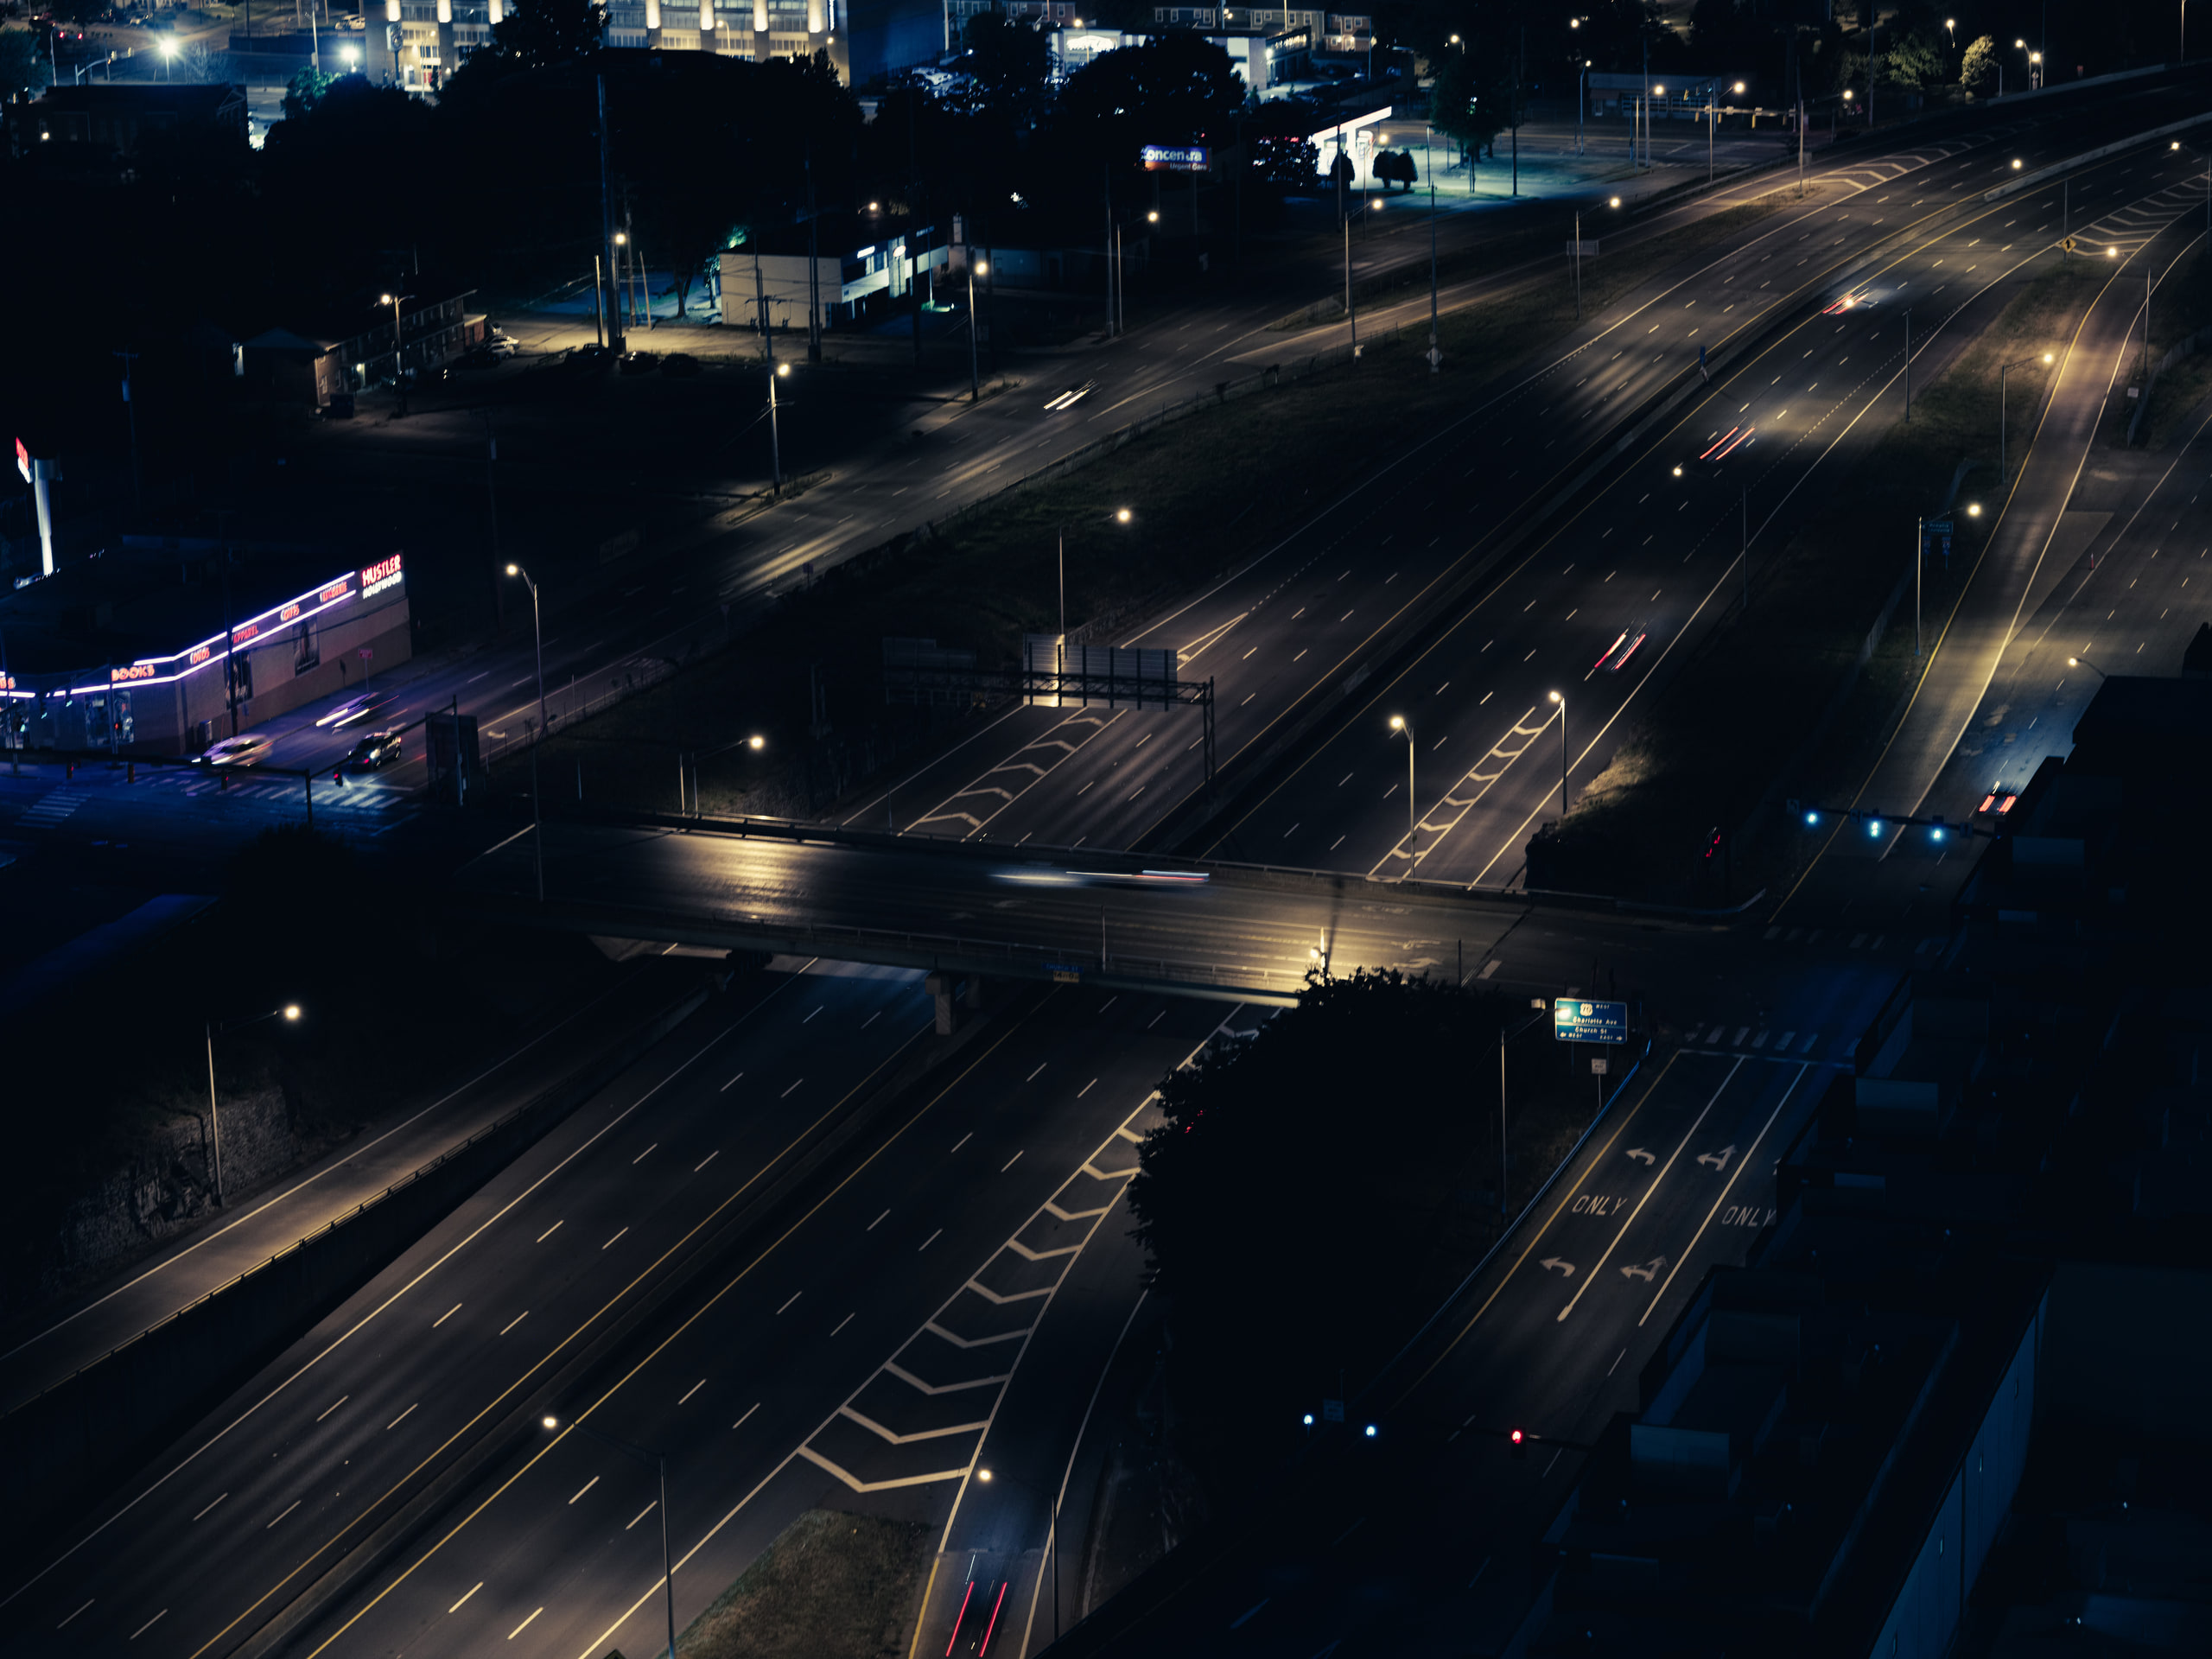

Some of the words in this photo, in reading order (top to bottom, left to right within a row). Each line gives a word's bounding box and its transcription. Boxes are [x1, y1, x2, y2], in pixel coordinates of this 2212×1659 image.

[1141, 149, 1202, 162] oncenra
[362, 554, 401, 588] HUSTLER
[232, 625, 258, 644] APPAREL
[111, 664, 155, 682] BOOKS
[1573, 1015, 1603, 1025] Charlotte
[1571, 1194, 1629, 1217] ONLY
[1721, 1205, 1777, 1228] ONLY
